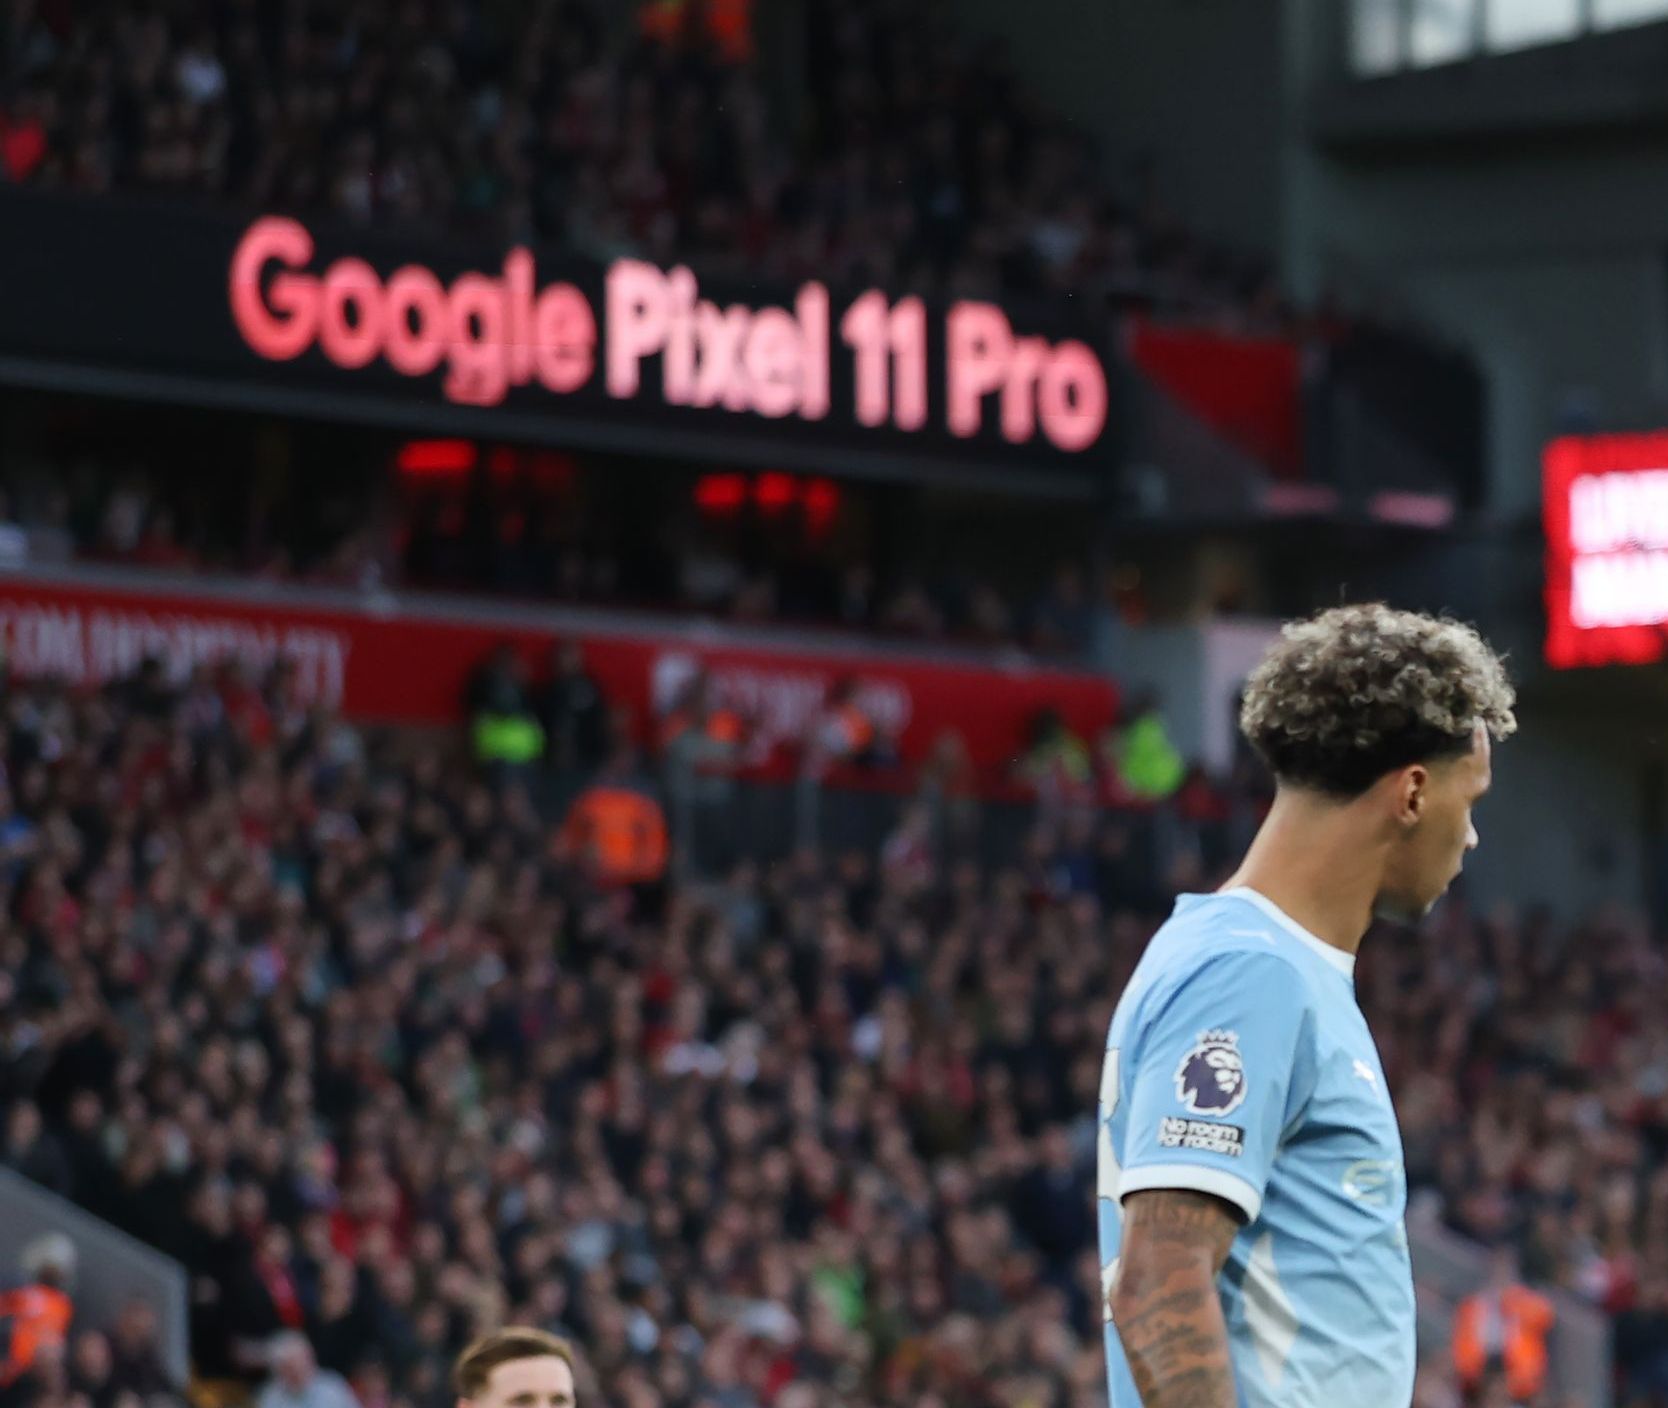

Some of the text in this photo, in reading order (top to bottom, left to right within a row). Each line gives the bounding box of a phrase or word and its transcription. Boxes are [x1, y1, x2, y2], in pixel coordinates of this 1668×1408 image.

[230, 215, 1107, 452] Google Pixel 11 Pro
[1187, 1121, 1240, 1141] room
